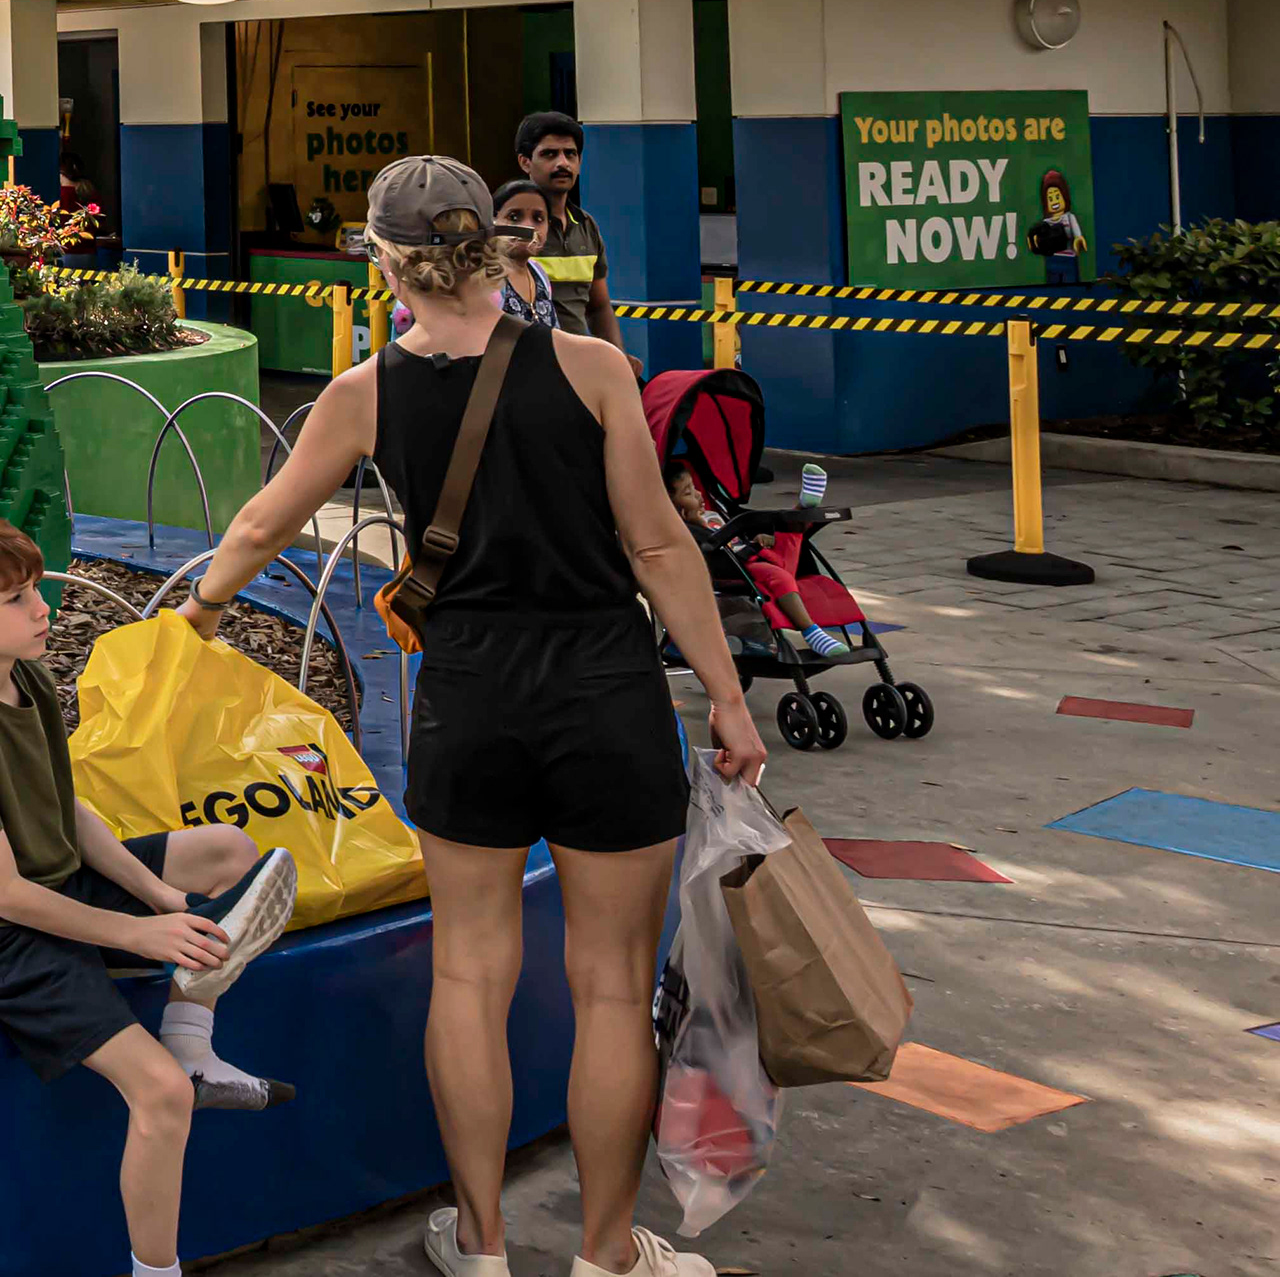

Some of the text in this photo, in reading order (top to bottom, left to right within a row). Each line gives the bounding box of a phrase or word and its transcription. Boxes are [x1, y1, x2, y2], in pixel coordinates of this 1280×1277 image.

[306, 101, 381, 121] See your
[306, 126, 409, 162] photos
[853, 113, 1066, 148] Your photos are
[322, 164, 377, 193] her
[858, 158, 1009, 207] READY
[886, 212, 1018, 264] NOW!
[180, 743, 380, 829] EGOLAND
